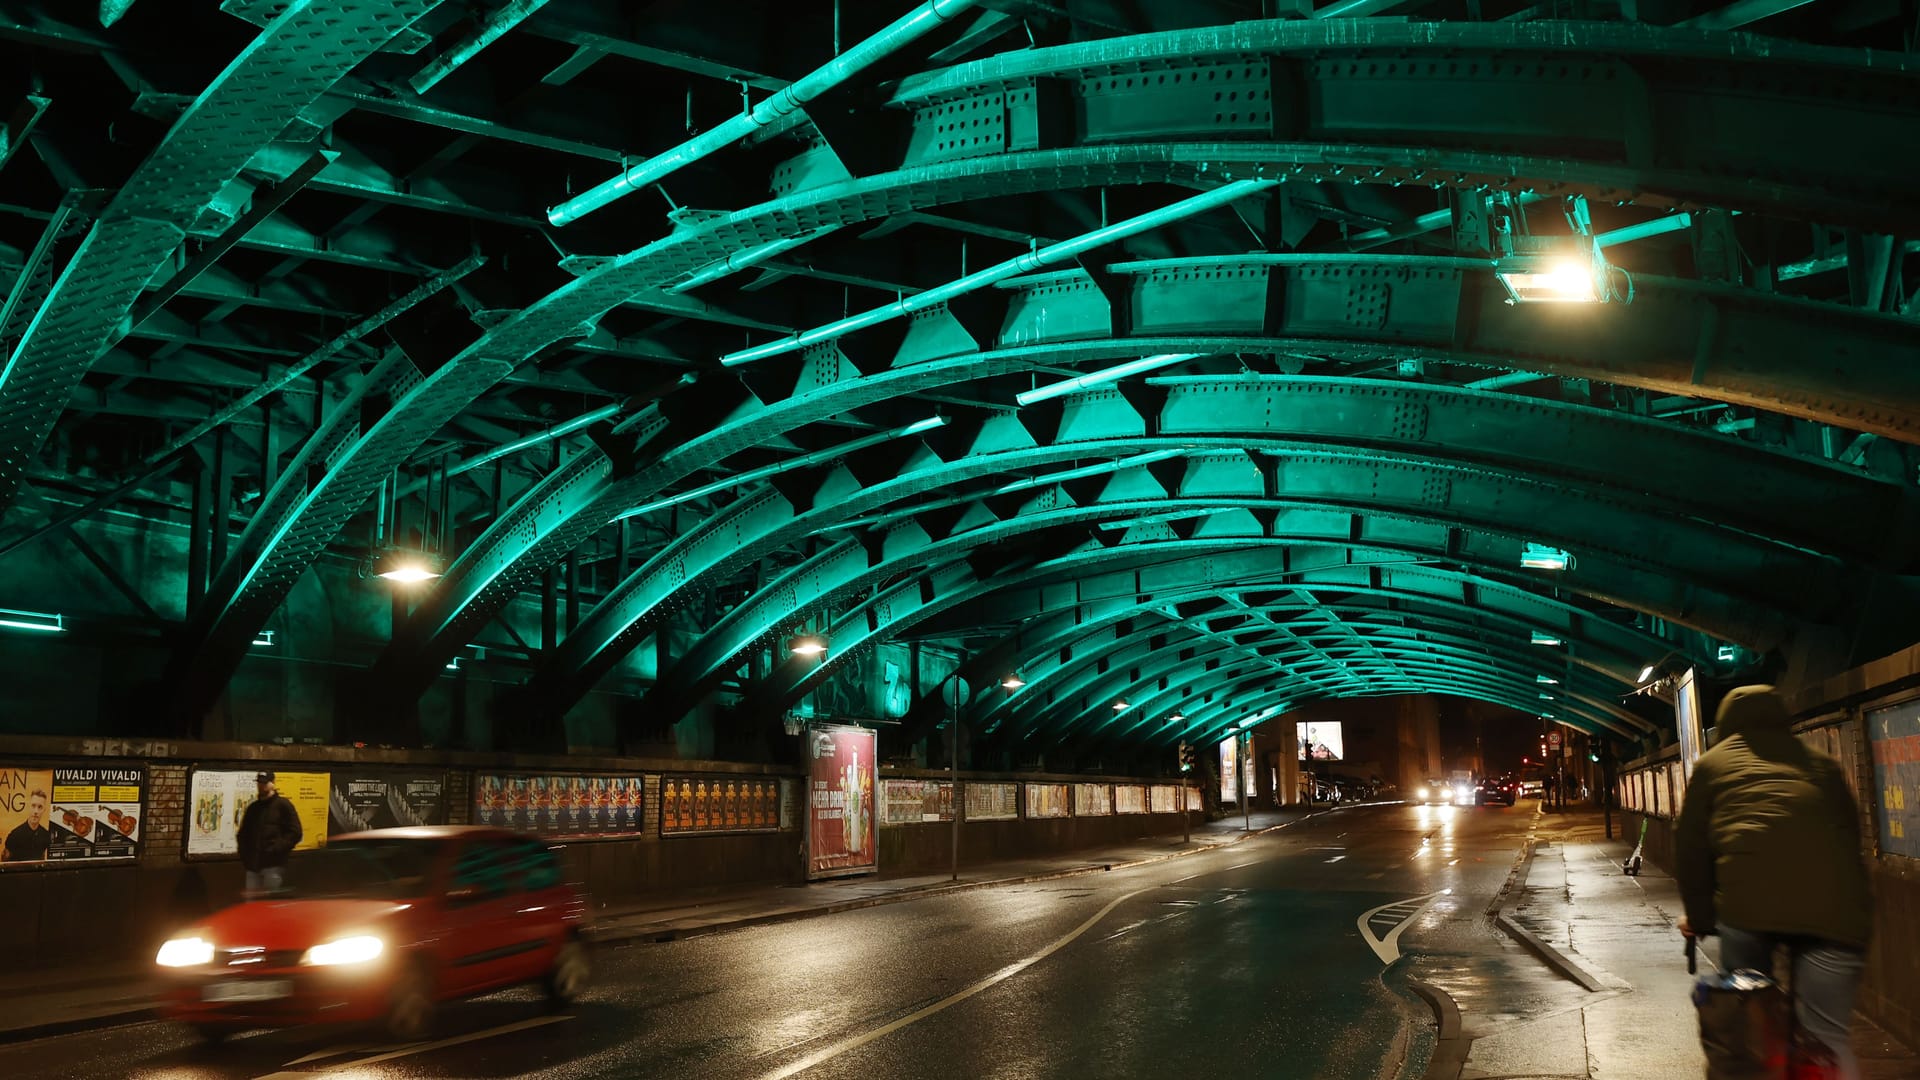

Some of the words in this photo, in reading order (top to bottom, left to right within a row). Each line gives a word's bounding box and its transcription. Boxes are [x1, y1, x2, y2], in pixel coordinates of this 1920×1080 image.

[55, 769, 97, 780] VIVALDI
[101, 770, 140, 781] VIVALDI
[812, 790, 829, 808] MEHR
